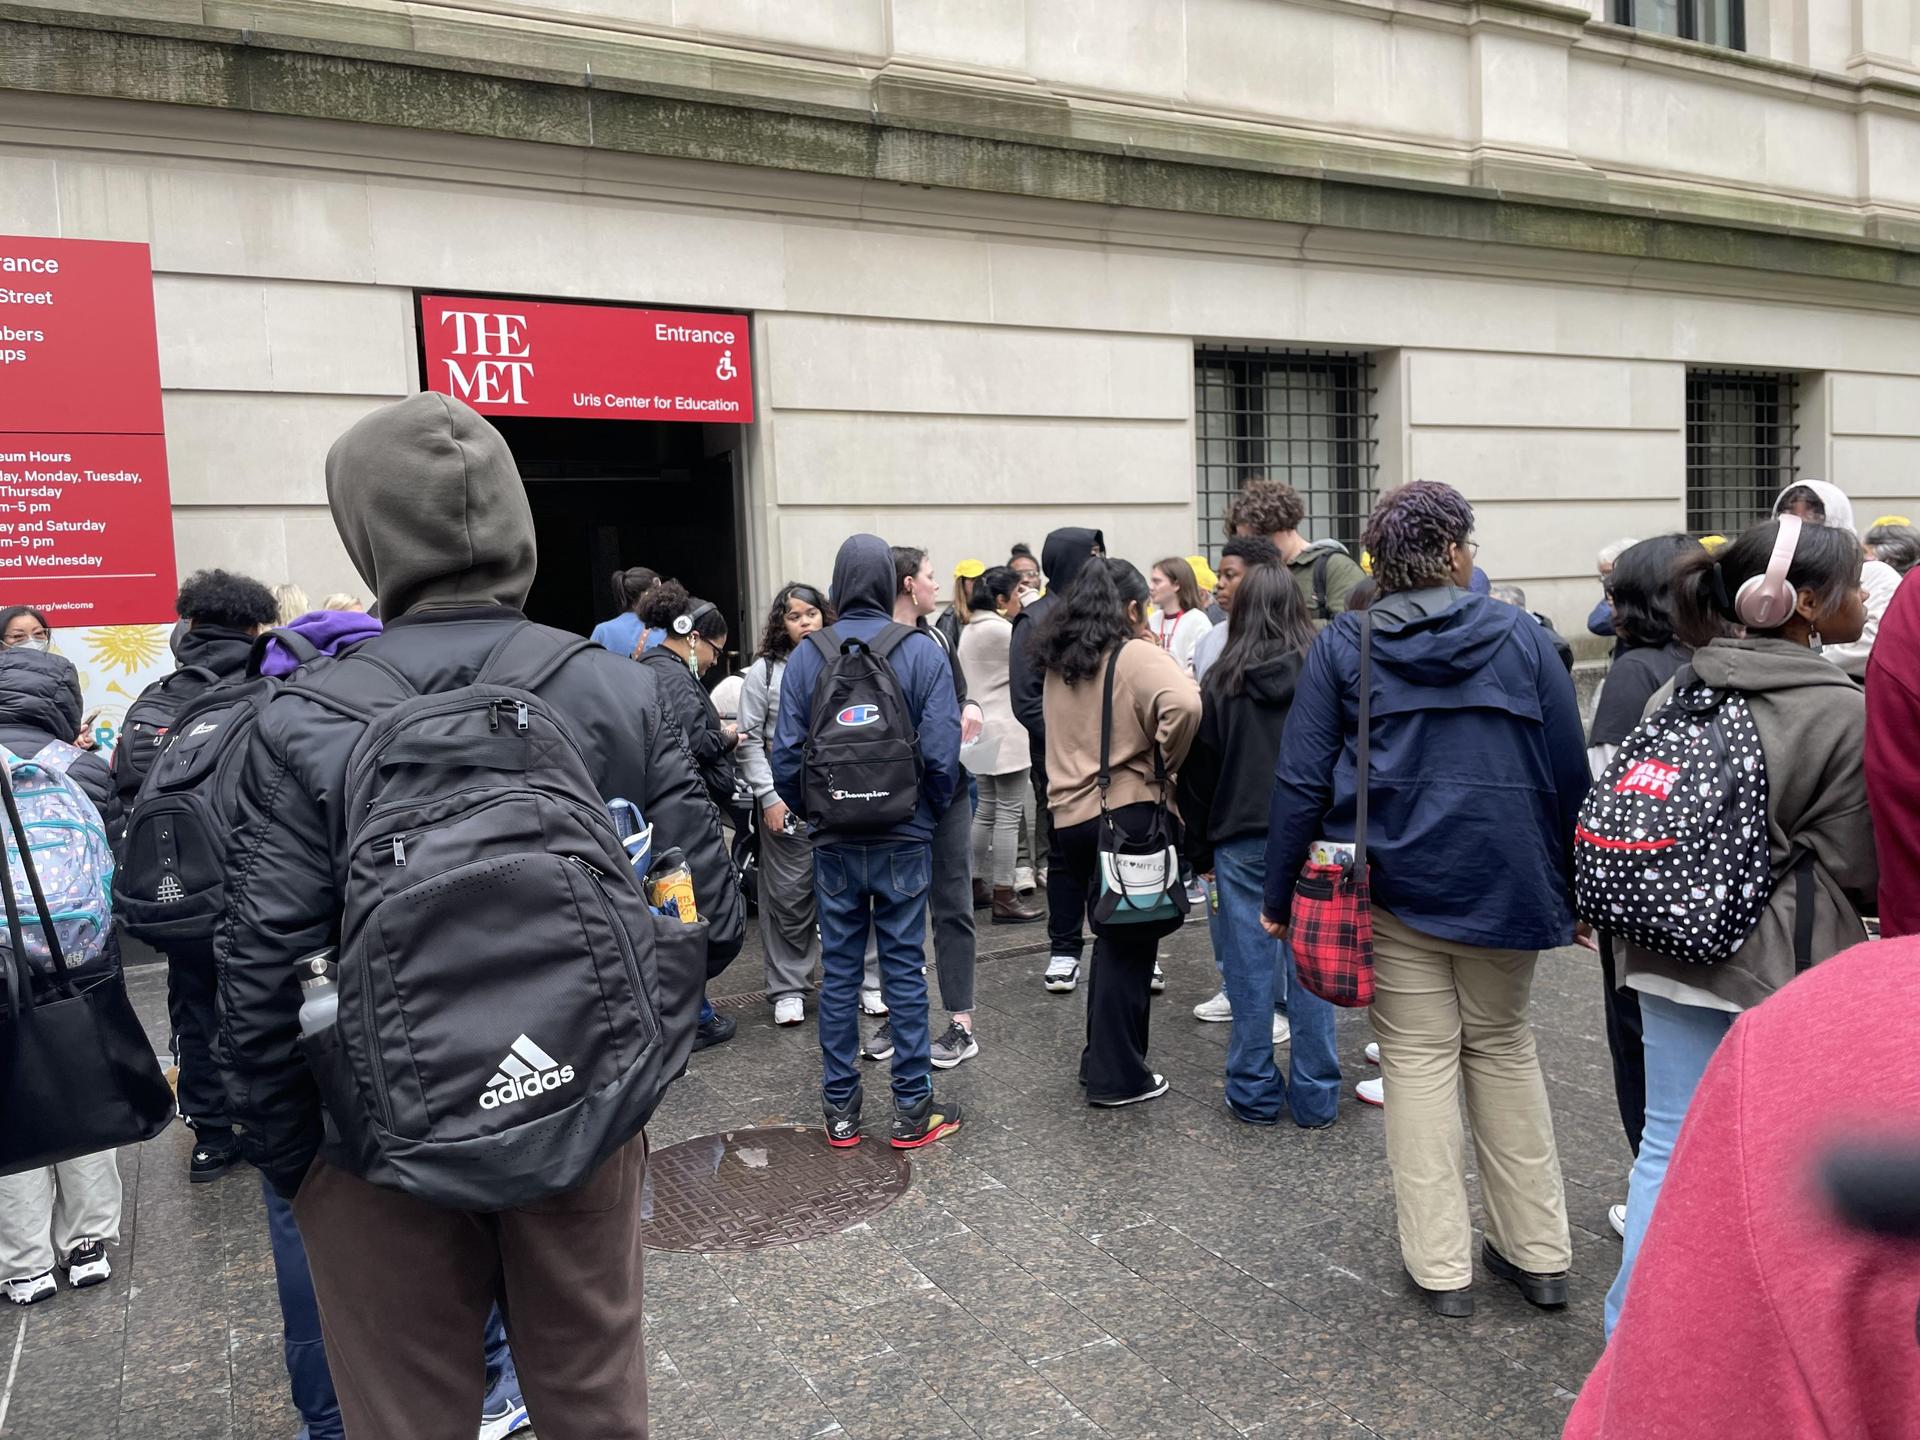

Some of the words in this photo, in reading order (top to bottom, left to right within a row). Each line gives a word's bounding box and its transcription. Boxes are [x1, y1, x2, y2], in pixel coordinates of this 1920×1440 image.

[0, 288, 54, 305] Street
[0, 325, 44, 342] bers
[441, 310, 530, 357] THE
[655, 323, 735, 344] Entrance
[441, 358, 535, 404] MET
[573, 393, 601, 407] Uris
[604, 394, 650, 408] Center
[653, 396, 672, 409] for
[675, 397, 739, 411] Education
[29, 451, 72, 462] Hours
[0, 470, 22, 484] ay,
[24, 470, 82, 484] Monday,
[84, 471, 142, 484] Tuesday,
[0, 485, 62, 499] Thursday
[30, 503, 51, 514] pm
[18, 520, 43, 531] and
[46, 520, 106, 533] Saturday
[33, 537, 54, 549] pm
[25, 554, 103, 567] Wednesday
[832, 790, 890, 801] Champion
[479, 1065, 575, 1110] adidas
